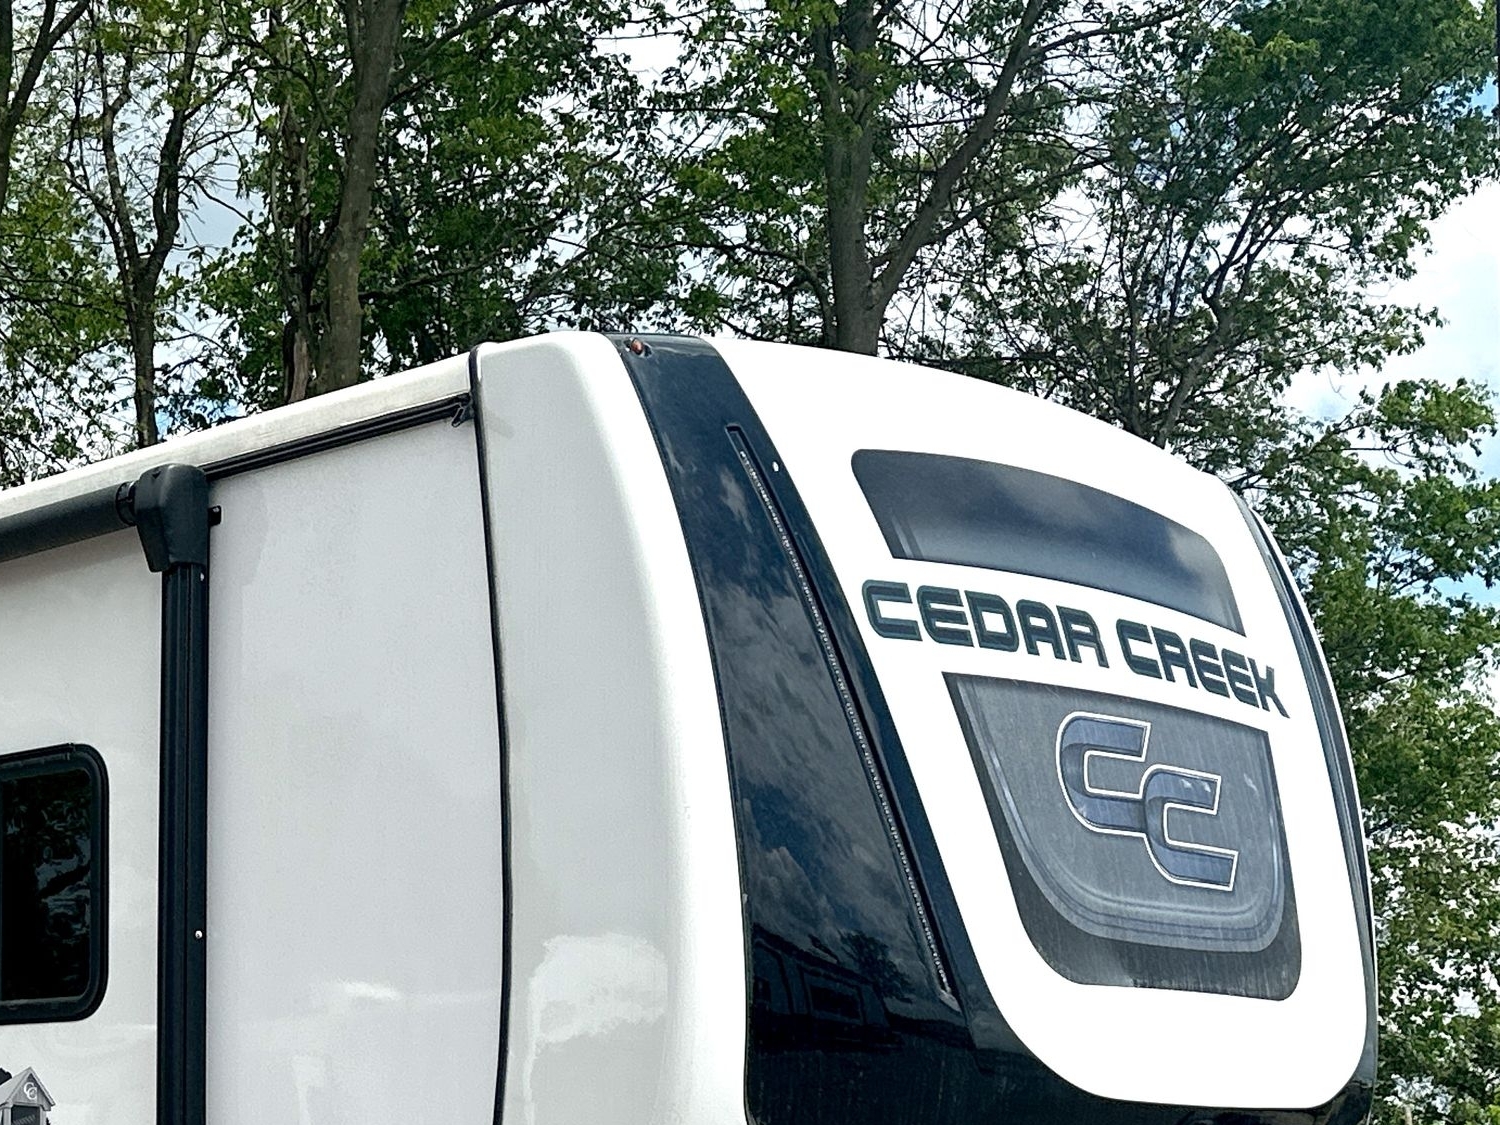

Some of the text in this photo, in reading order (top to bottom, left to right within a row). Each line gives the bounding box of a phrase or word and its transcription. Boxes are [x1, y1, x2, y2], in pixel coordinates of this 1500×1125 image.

[862, 579, 1291, 720] CEDAR CREEK
[1055, 710, 1240, 892] CC
